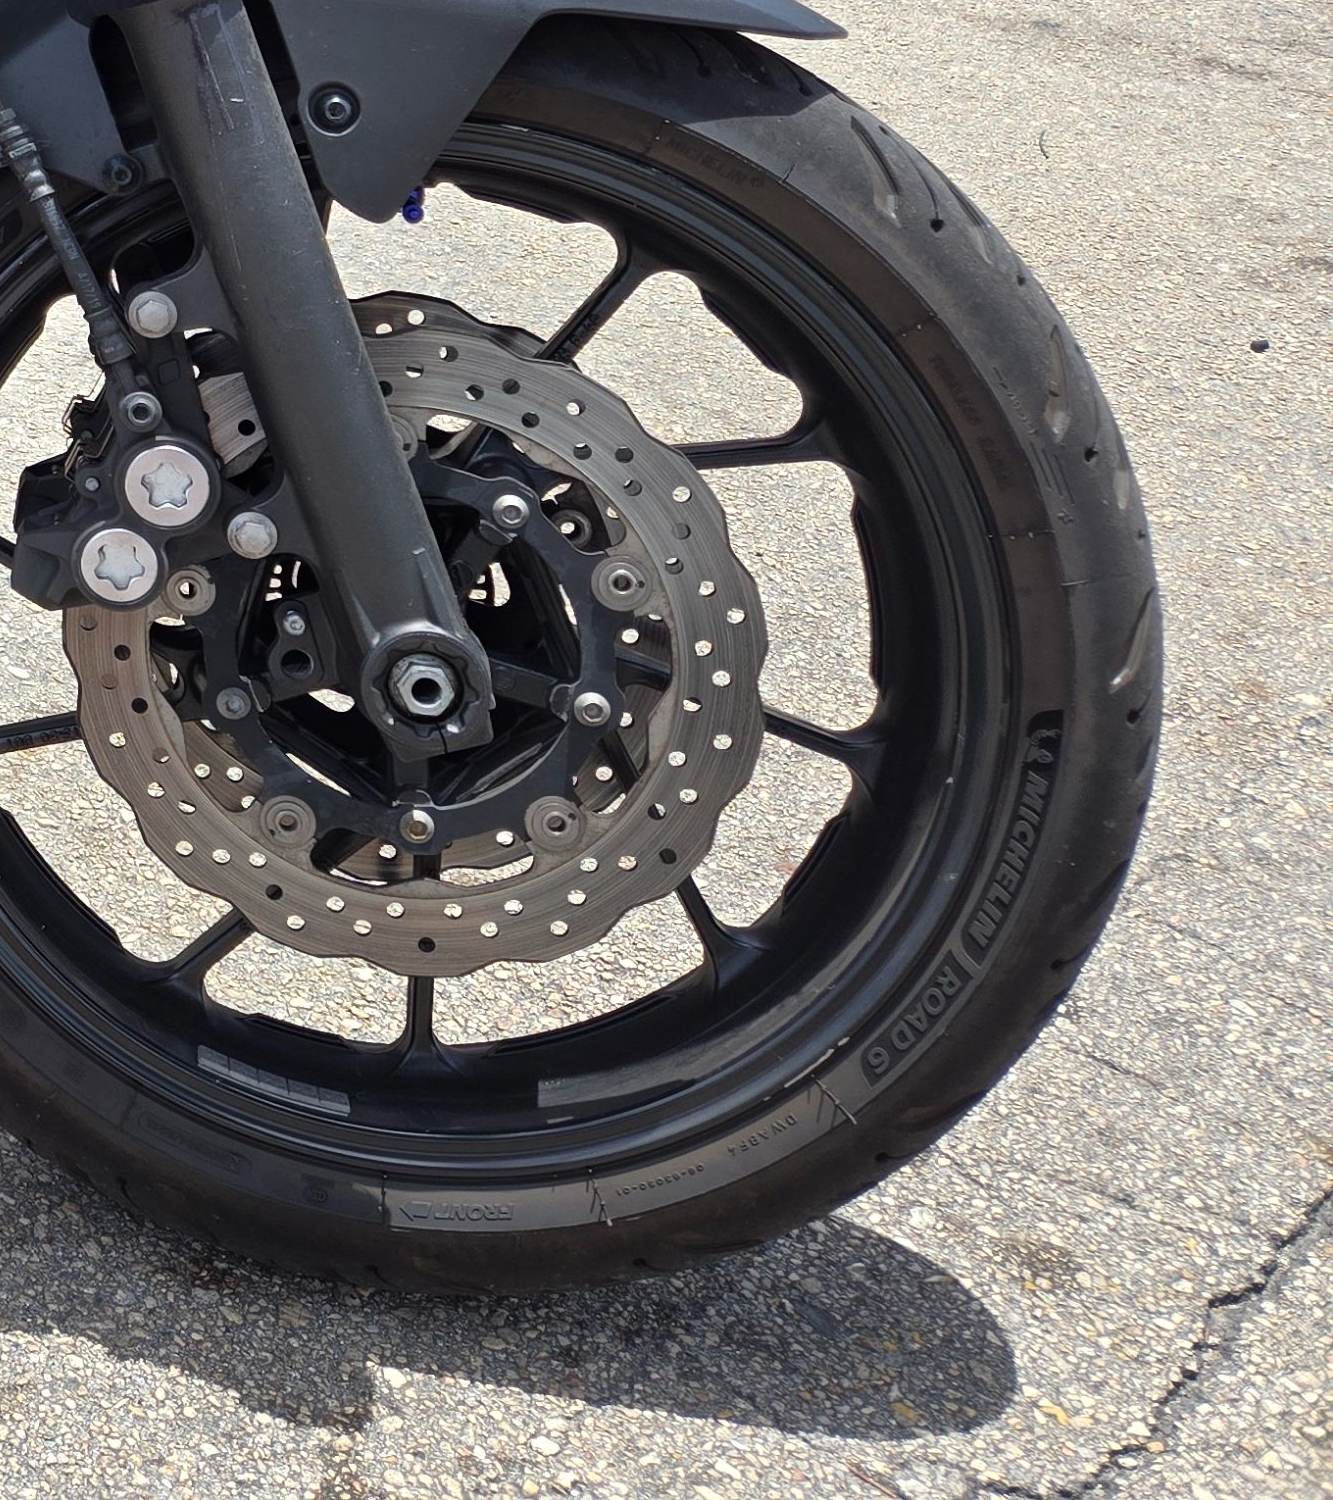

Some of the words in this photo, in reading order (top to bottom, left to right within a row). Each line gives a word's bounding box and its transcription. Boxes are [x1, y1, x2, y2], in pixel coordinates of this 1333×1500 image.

[966, 769, 1050, 948] MICHELIN
[889, 964, 962, 1050] ROAD
[866, 1045, 890, 1076] 6
[432, 1202, 516, 1223] FRONT
